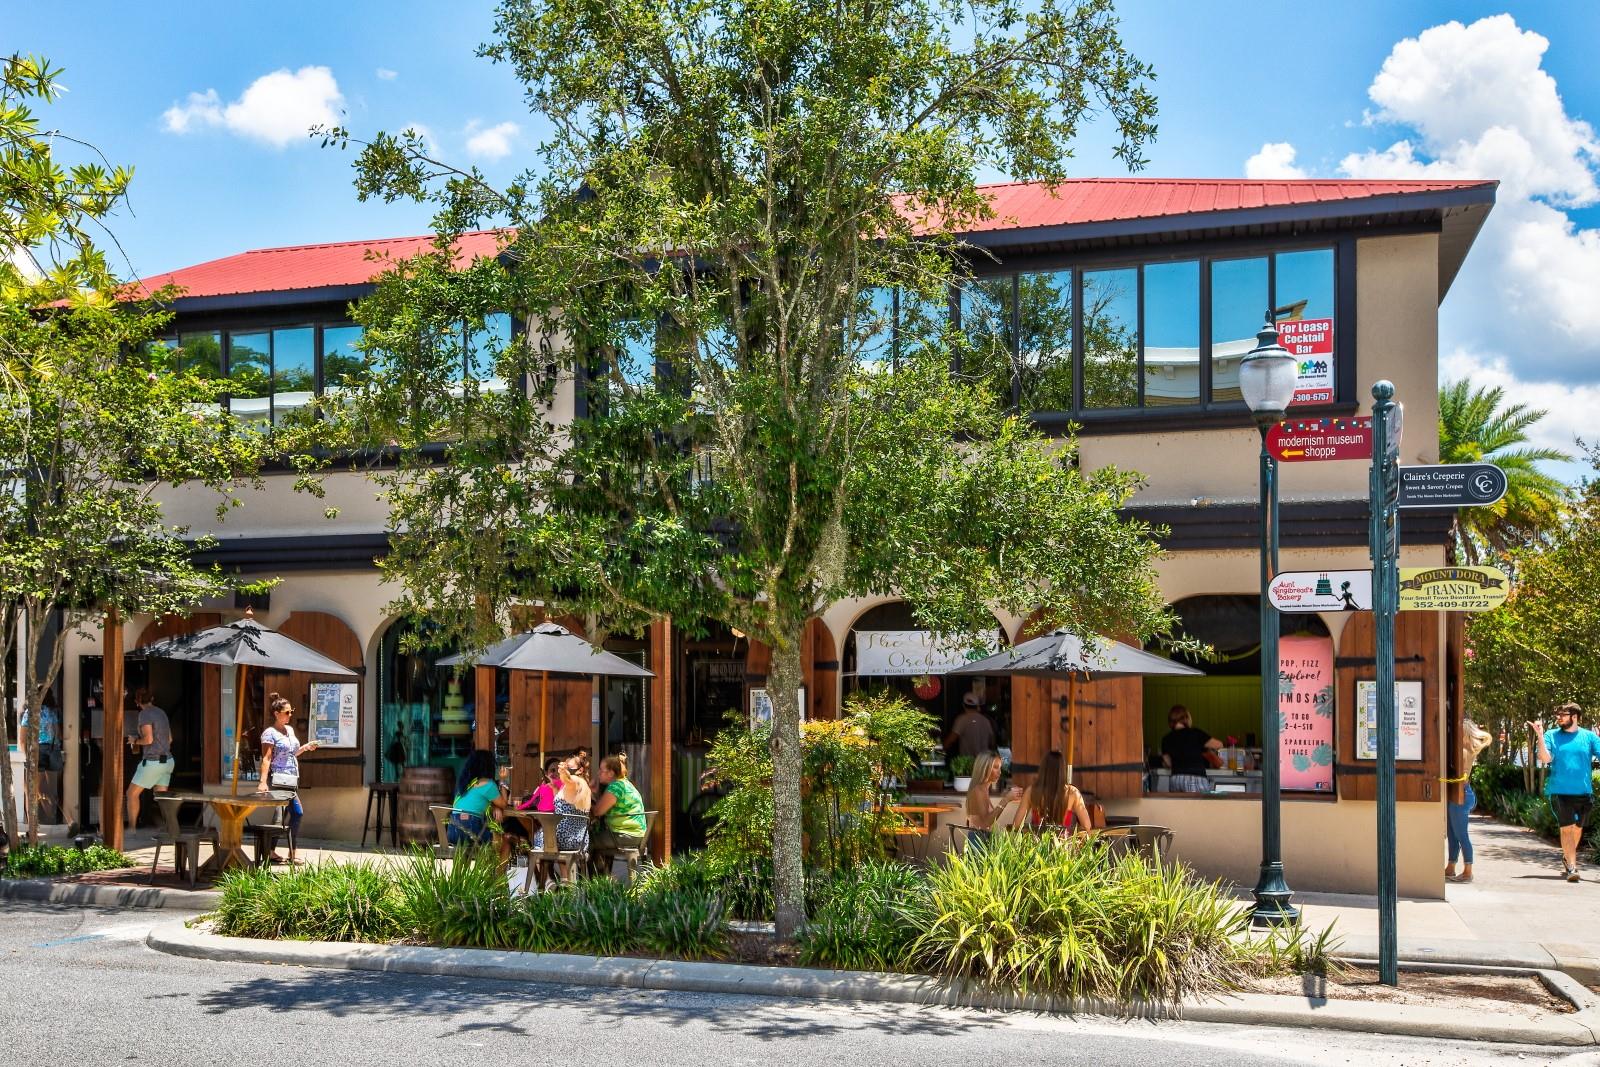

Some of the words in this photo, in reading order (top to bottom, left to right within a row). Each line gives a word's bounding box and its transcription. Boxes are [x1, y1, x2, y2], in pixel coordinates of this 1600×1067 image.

[1280, 323, 1297, 333] For
[1298, 322, 1329, 332] Lease
[1284, 332, 1325, 344] Cocktail
[1296, 344, 1313, 354] Bar
[1278, 435, 1324, 447] modernism
[1327, 434, 1363, 445] museum
[1305, 446, 1336, 459] shoppe
[1403, 472, 1431, 481] Claire's
[1432, 472, 1465, 481] Creperie
[1416, 570, 1454, 584] MOUNT
[1455, 570, 1486, 583] DORA
[1424, 583, 1478, 596] TRANSIT
[864, 632, 904, 649] The
[1280, 660, 1298, 668] POP,
[1279, 670, 1321, 683] Explore!
[1280, 693, 1327, 703] IMOSAS
[1284, 738, 1325, 746] SPARKLING
